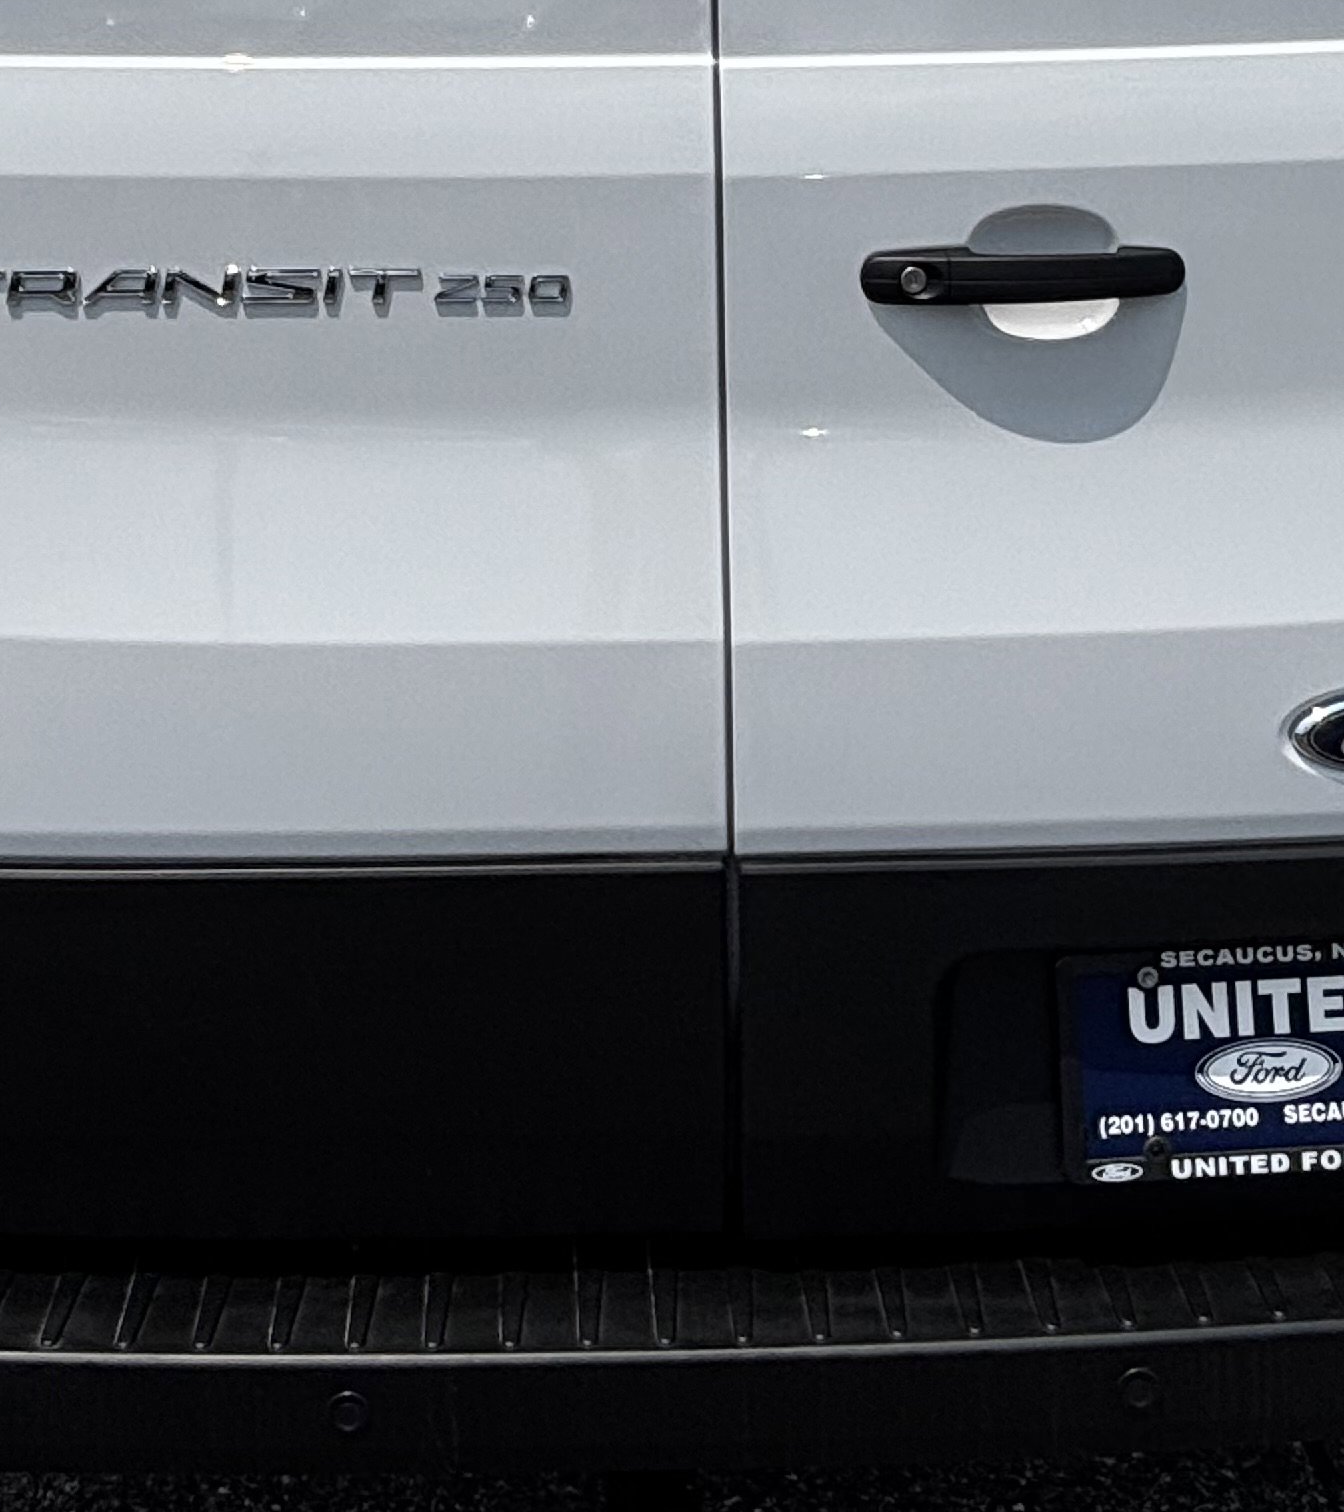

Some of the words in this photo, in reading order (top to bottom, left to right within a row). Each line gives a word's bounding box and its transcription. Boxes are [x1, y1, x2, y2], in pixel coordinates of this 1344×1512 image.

[434, 273, 572, 314] 250
[1160, 944, 1323, 968] SECAUCUS,
[1230, 1051, 1307, 1085] Ford
[1099, 1113, 1155, 1139] (201)
[1160, 1108, 1260, 1133] 617-0700
[1170, 1153, 1290, 1179] UNITED
